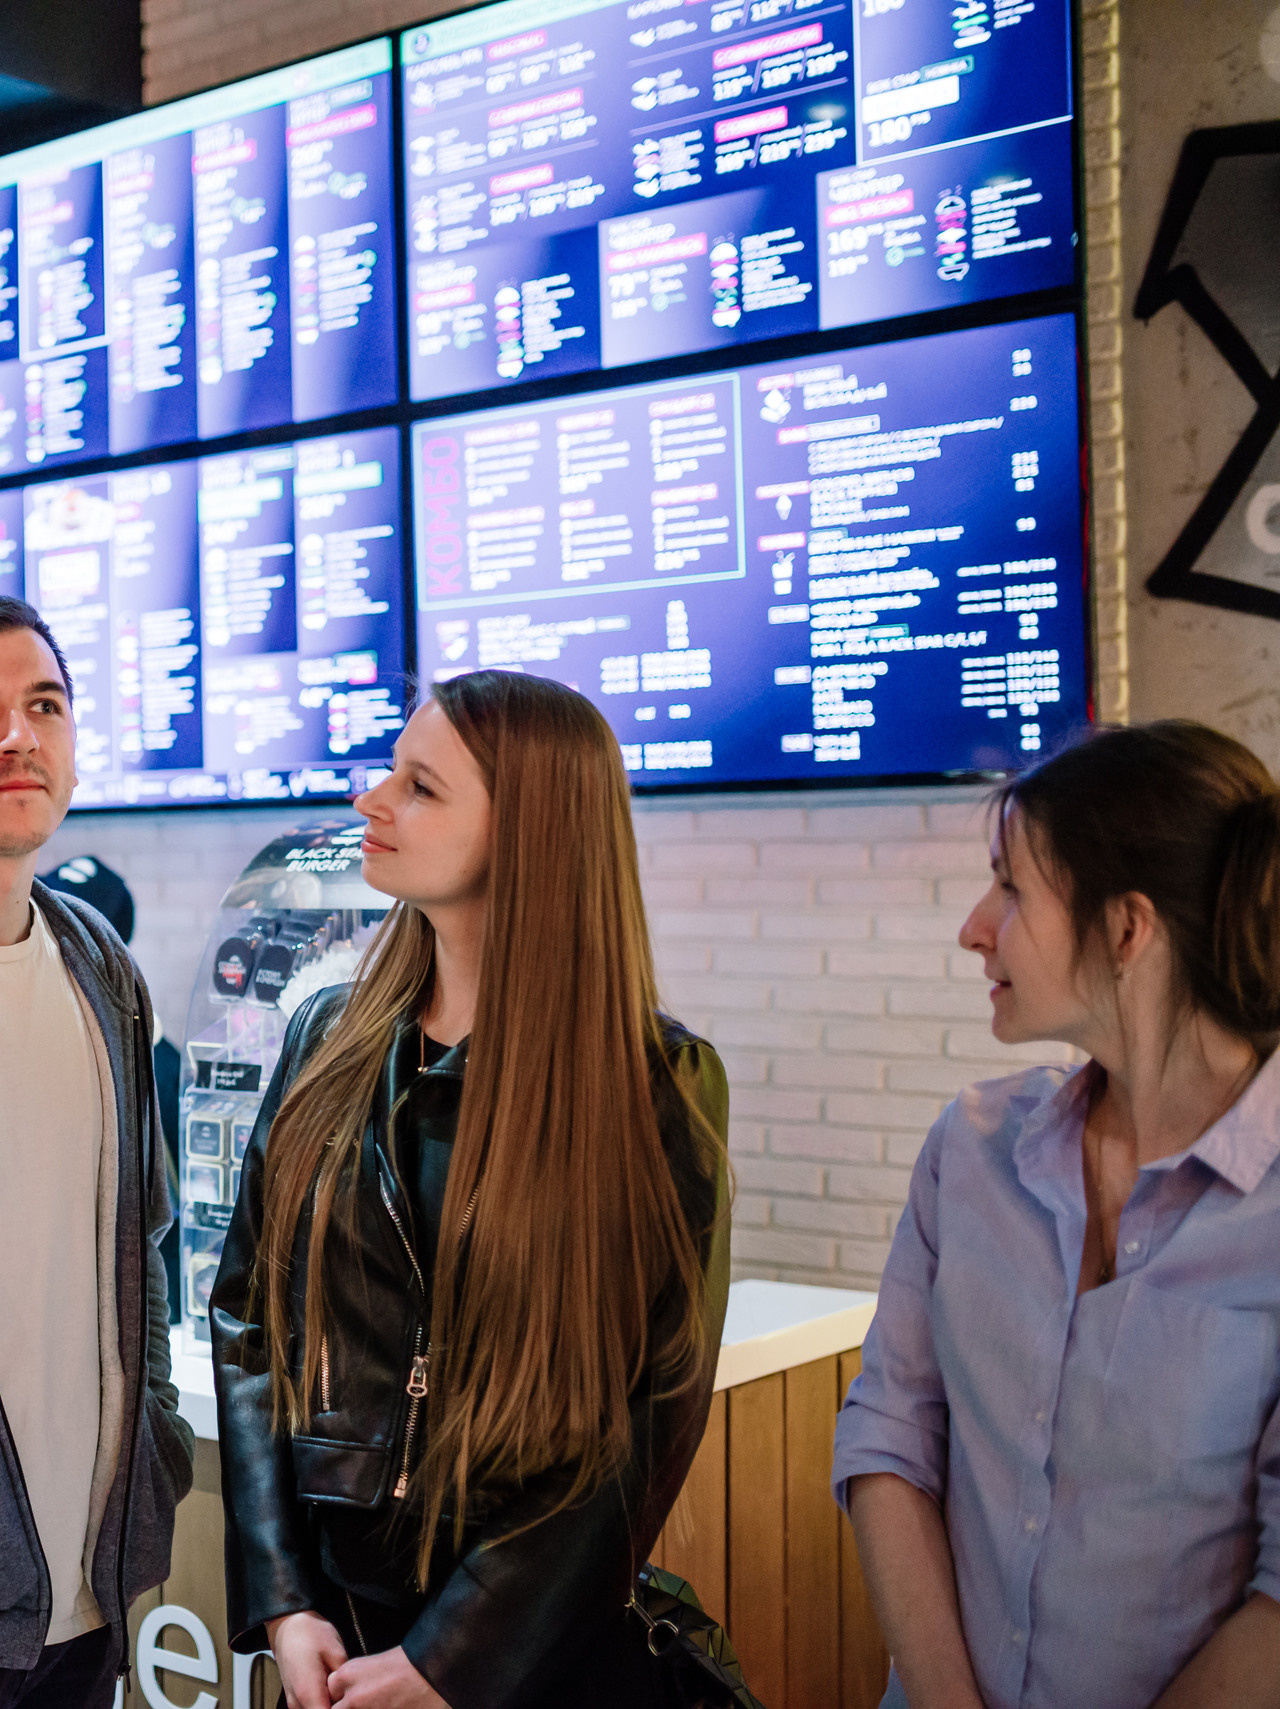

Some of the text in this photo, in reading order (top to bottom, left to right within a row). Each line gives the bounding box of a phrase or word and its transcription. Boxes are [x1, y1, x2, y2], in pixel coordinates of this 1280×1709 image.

[422, 436, 463, 597] КОМБО
[285, 846, 365, 860] BLACK STA
[286, 859, 351, 872] BURGER
